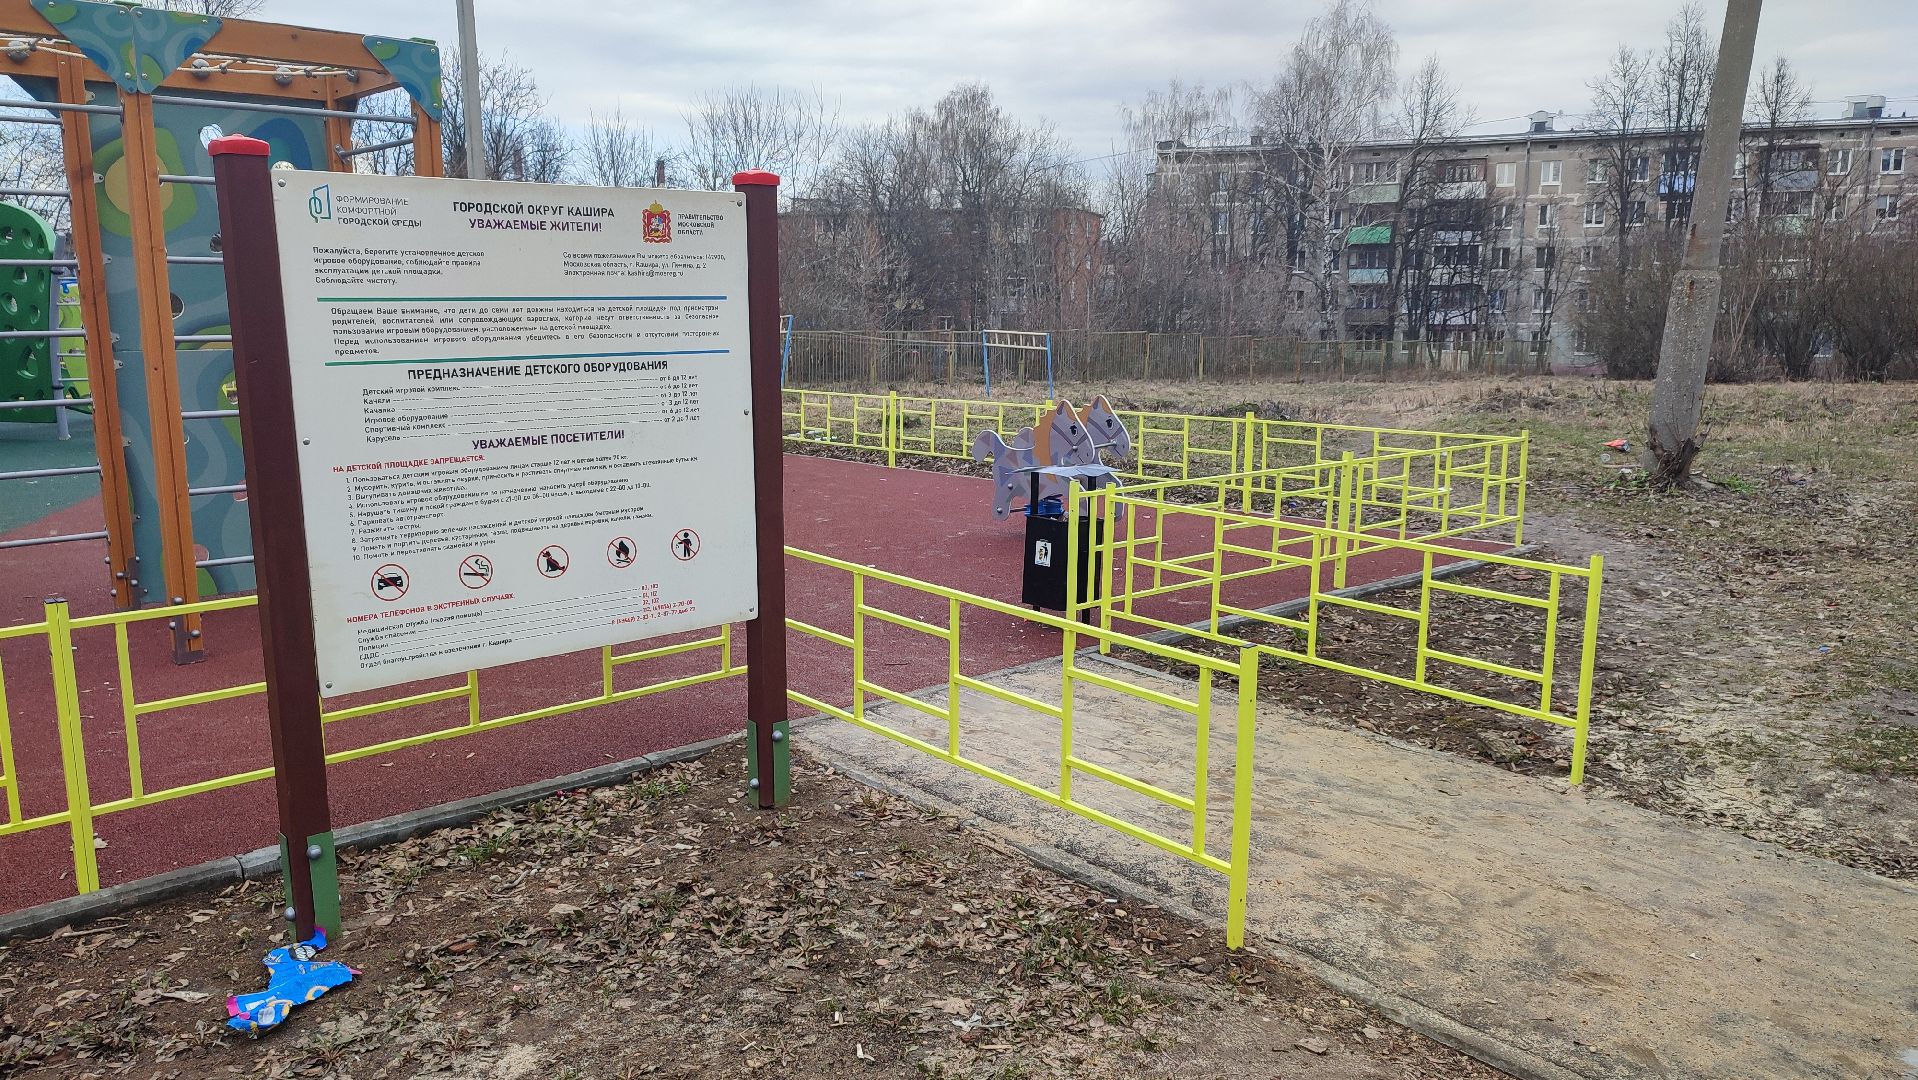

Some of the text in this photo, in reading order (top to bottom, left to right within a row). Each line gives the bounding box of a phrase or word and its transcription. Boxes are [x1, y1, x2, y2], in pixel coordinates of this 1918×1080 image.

[335, 195, 408, 205] ФОРМИРОВАНИЕ
[336, 205, 396, 215] КОМФОРТНОЙ
[452, 201, 614, 217] ГОРОДСКОЙ ОКРУГ КАШИРА
[337, 216, 421, 228] ГОРОДСКОЙ СРЕДЫ
[677, 213, 723, 221] ПРАВИТЕЛЬСТВО
[468, 218, 601, 232] УВАЖАЕМЫЕ ЖИТЕЛИ!
[407, 360, 667, 380] ПРЕДНАЗНАЧЕНИЕ ДЕТСКОГО ОБОРУДОВАНИЯ
[471, 429, 624, 450] УВАЖАЕМЫЕ ПОСЕТИТЕЛИ!
[346, 461, 382, 473] ДЕТСКОЙ
[384, 458, 428, 469] ПЛОЩАДКЕ
[430, 454, 485, 465] ЗАПРЕЩАЕТСЯ:
[346, 613, 378, 623] НОМЕРА
[379, 606, 425, 618] ТЕЛЕФОНОВ
[433, 597, 480, 610] ЭКСТРЕННЫХ
[481, 592, 515, 602] СЛУЧАЯХ:
